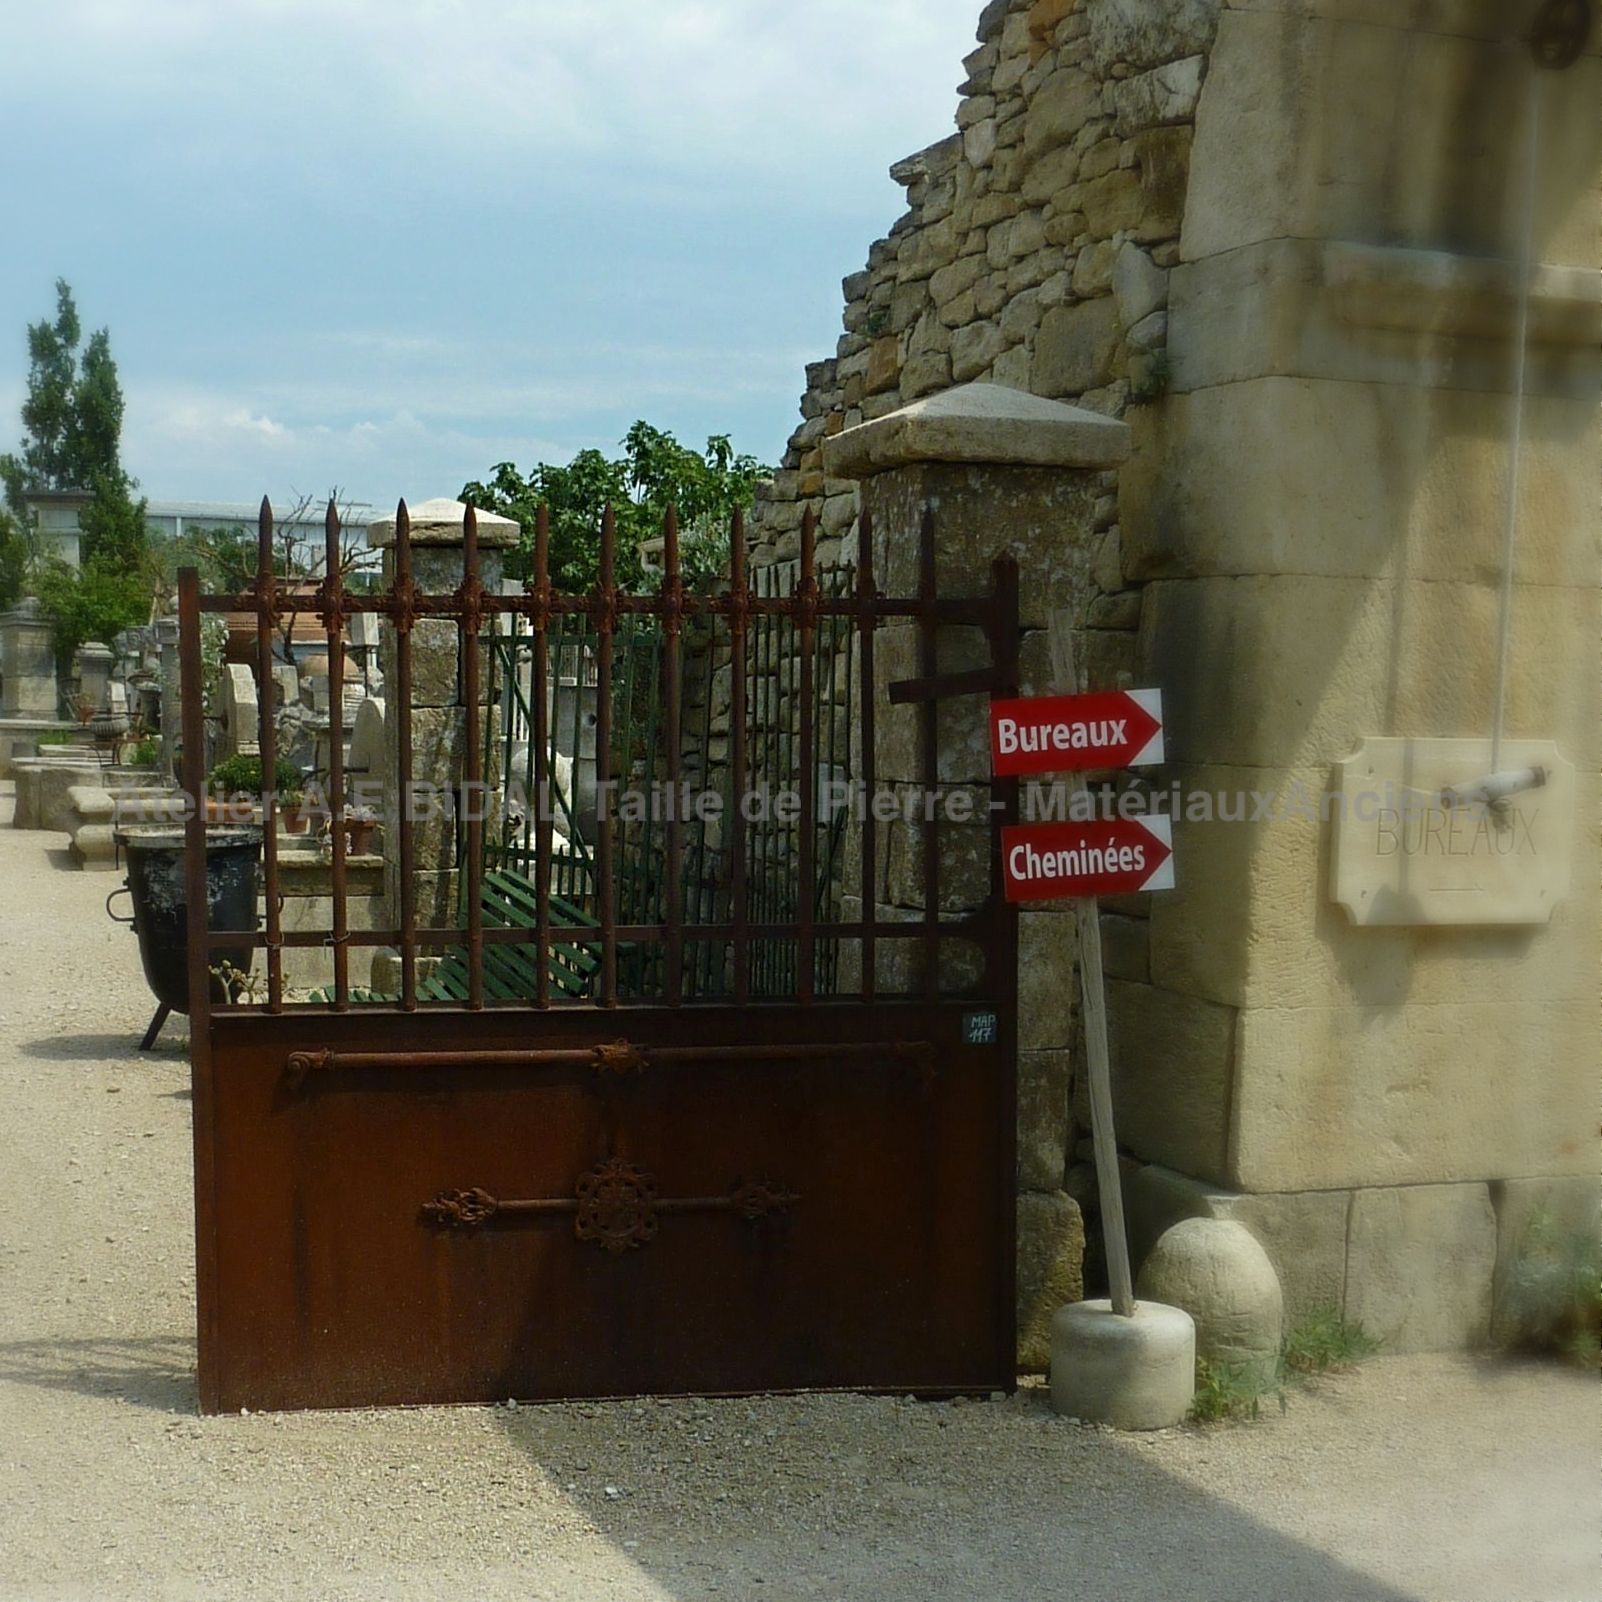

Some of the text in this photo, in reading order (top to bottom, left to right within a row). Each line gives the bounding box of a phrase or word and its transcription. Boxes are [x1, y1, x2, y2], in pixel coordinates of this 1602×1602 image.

[998, 718, 1128, 754] Bureaux
[1376, 807, 1540, 856] BUREAUX
[1009, 837, 1146, 881] Cheminées
[971, 1014, 996, 1028] MAP
